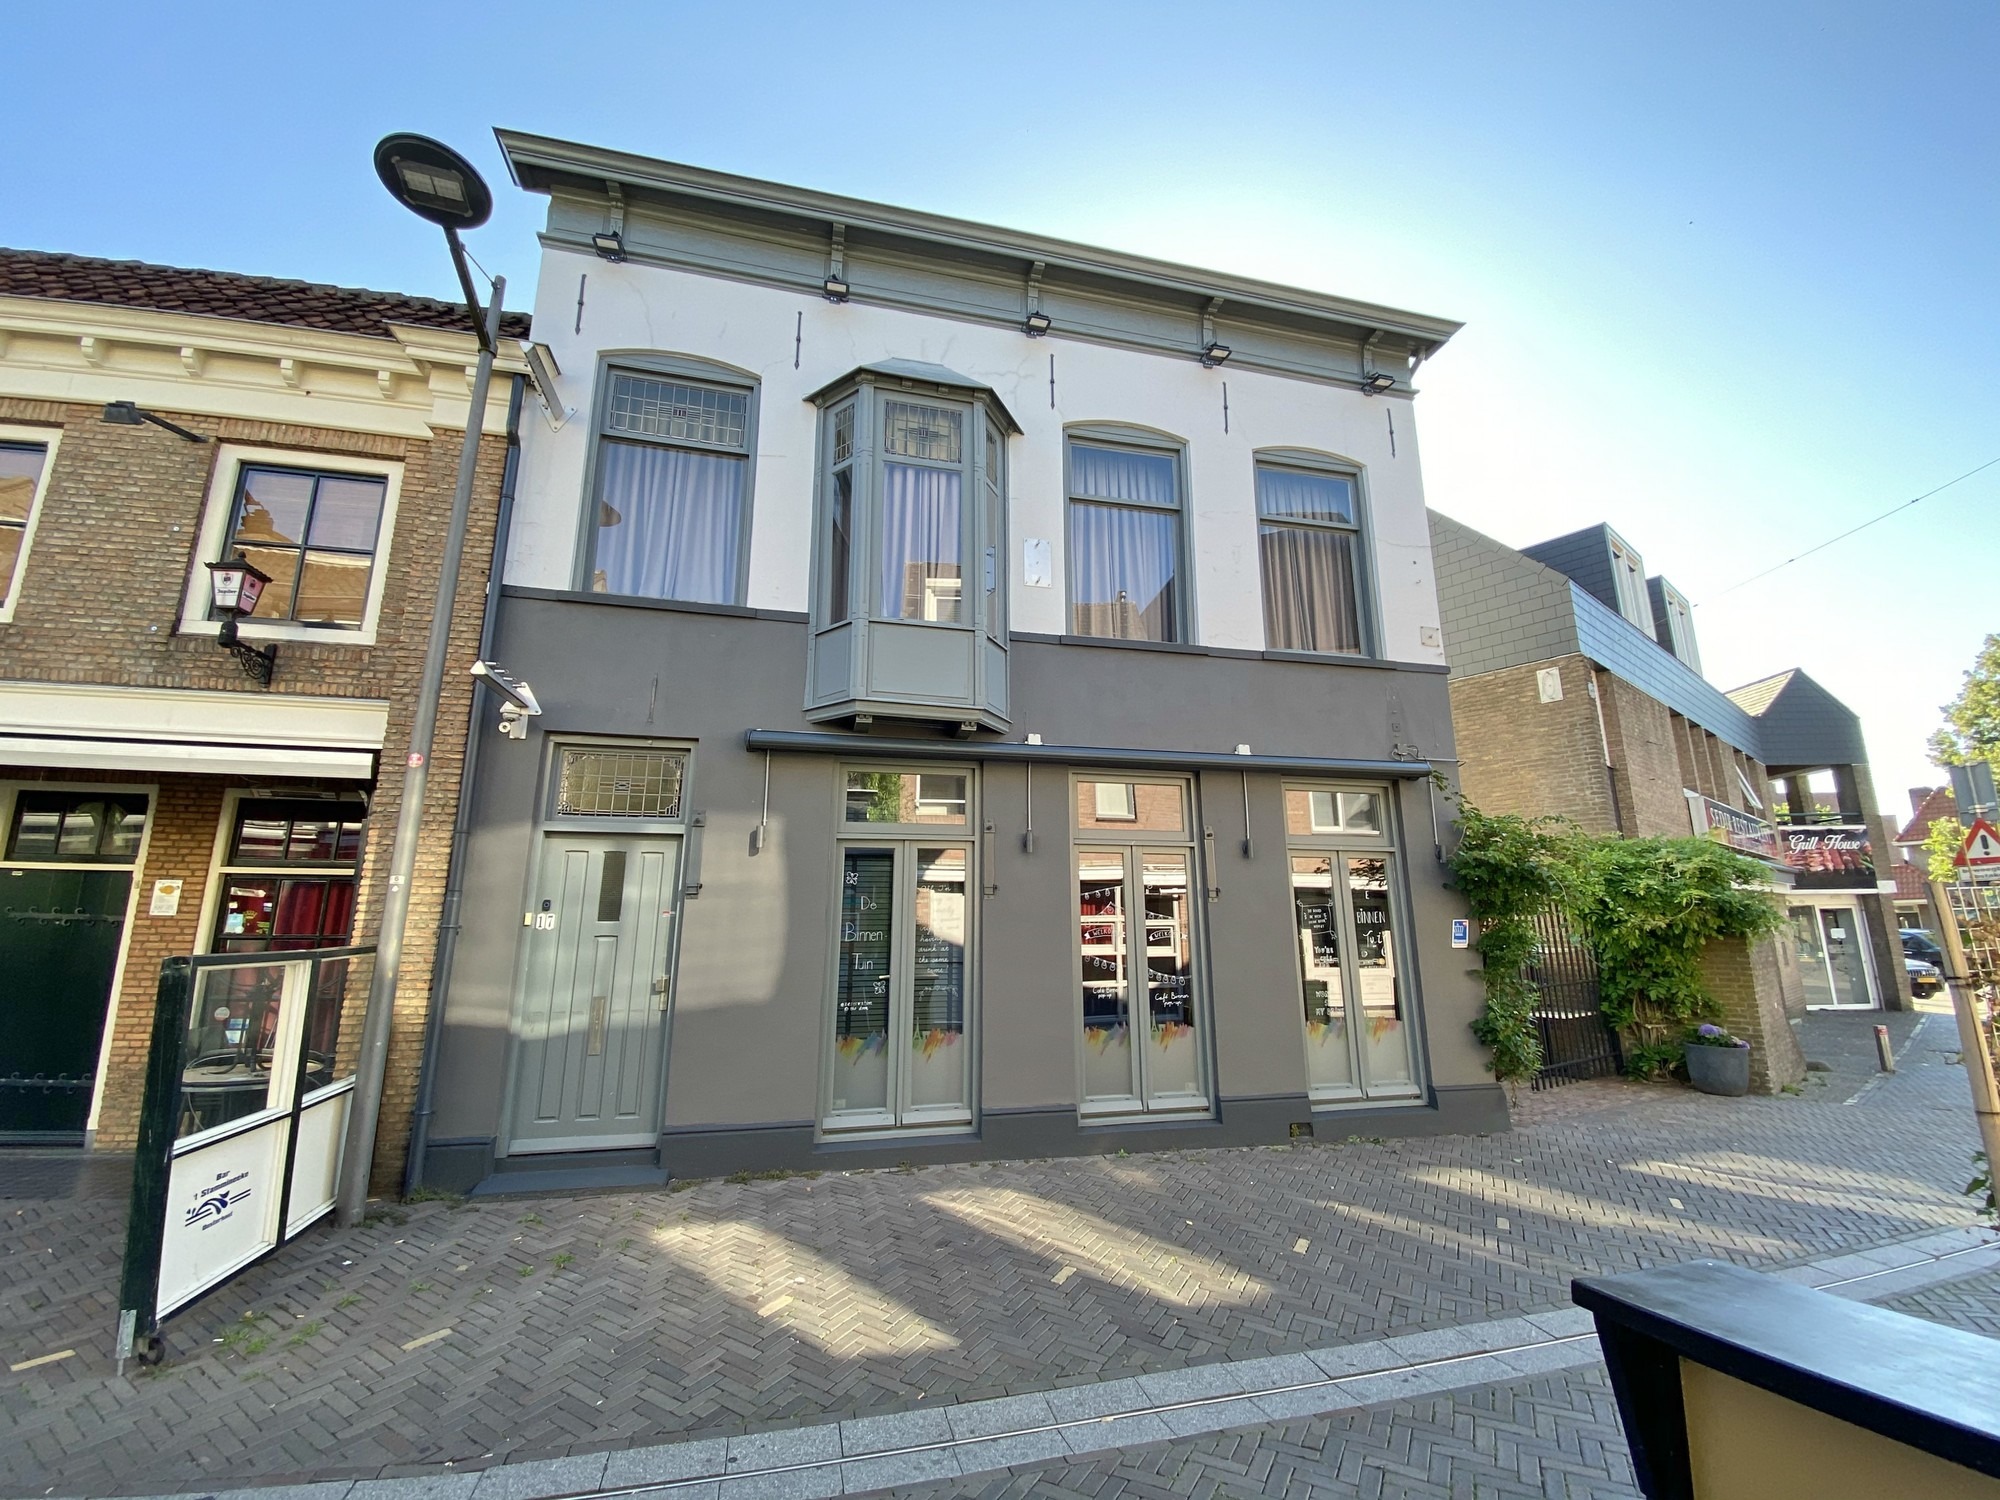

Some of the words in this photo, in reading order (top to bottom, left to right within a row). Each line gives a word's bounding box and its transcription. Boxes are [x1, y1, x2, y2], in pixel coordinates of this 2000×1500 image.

[1788, 834, 1819, 855] Grill
[1822, 834, 1861, 850] House
[860, 895, 878, 911] De
[537, 914, 554, 929] 17
[851, 952, 874, 971] Tuin
[216, 1170, 230, 1181] Bar
